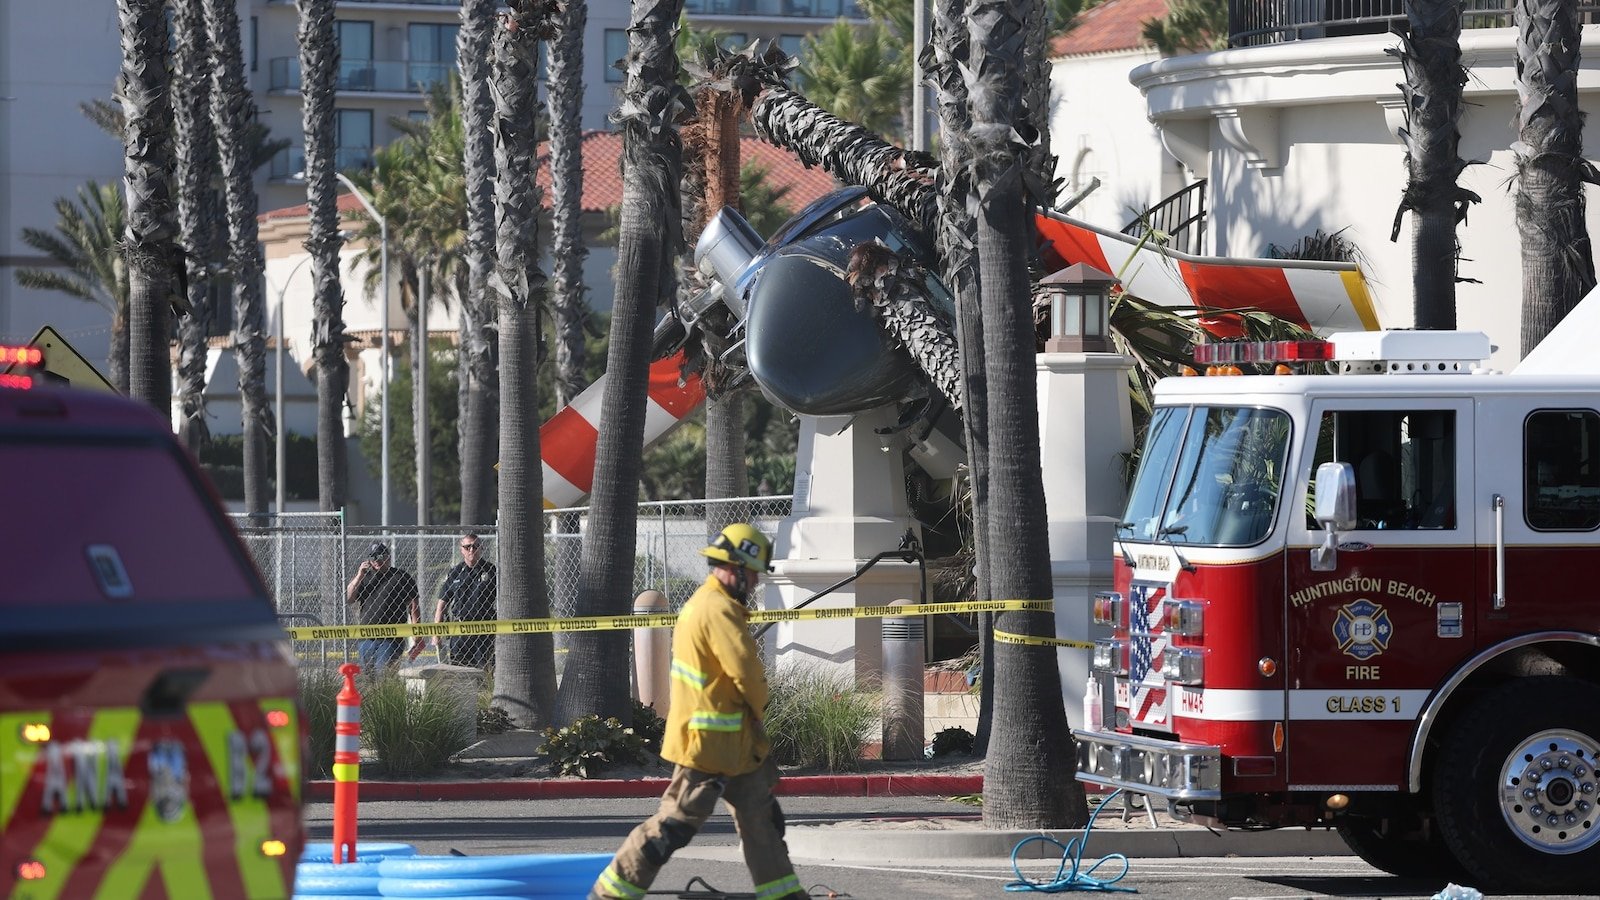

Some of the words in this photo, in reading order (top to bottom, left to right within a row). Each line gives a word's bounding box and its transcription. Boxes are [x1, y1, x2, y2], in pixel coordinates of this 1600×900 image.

[741, 540, 759, 556] T6
[1290, 577, 1382, 607] HUNTINGTON
[1387, 580, 1437, 608] BEACH
[762, 610, 800, 621] CUIDADO
[815, 608, 853, 619] CAUTION
[864, 605, 903, 616] CUIDADO
[918, 604, 956, 613] CAUTION
[312, 628, 350, 639] CAUTION
[360, 626, 398, 638] CUIDADO
[412, 625, 450, 636] CAUTION
[459, 623, 497, 634] CUIDADO
[512, 621, 549, 631] CAUTION
[559, 619, 597, 630] CUIDADO
[612, 617, 650, 628] CAUTION
[1354, 623, 1372, 636] HB
[1346, 665, 1381, 680] FIRE
[1327, 695, 1387, 713] CLASS
[1391, 696, 1401, 713] 1
[41, 738, 128, 814] ANA
